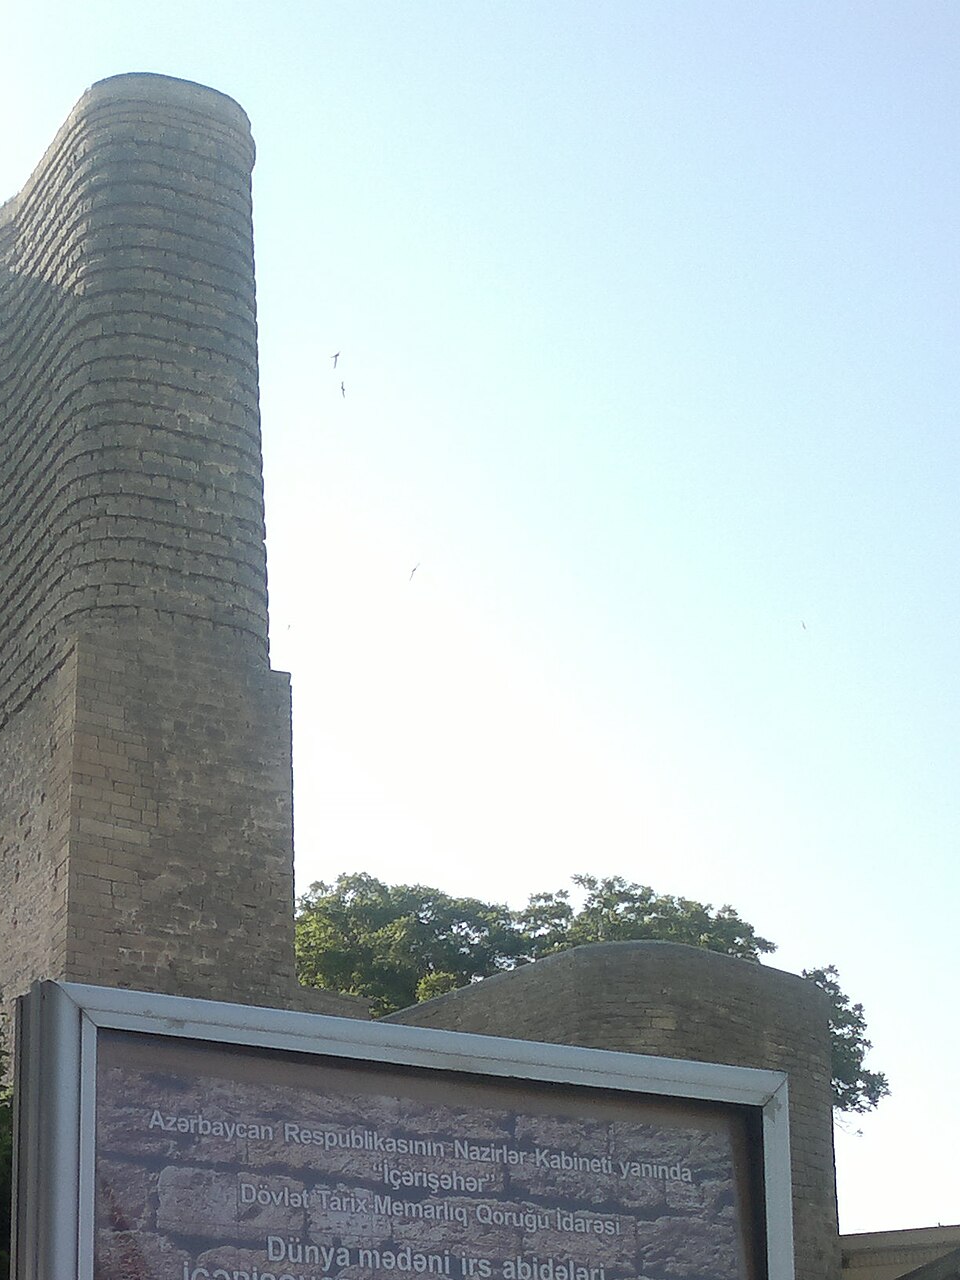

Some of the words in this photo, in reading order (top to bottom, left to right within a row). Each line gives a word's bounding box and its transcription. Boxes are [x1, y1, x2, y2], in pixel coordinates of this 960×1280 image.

[148, 1110, 273, 1142] Azərbaycan
[284, 1124, 444, 1157] Respublikasının
[454, 1139, 527, 1165] Nazirlər
[536, 1148, 612, 1174] Kabineti
[620, 1160, 692, 1183] yanında
[240, 1182, 310, 1208] Dövlət
[476, 1204, 550, 1232] Qoruğu
[556, 1207, 620, 1236] İdarəsi
[267, 1234, 350, 1271] Dünya
[359, 1247, 450, 1274] mədəni
[461, 1252, 491, 1277] irs
